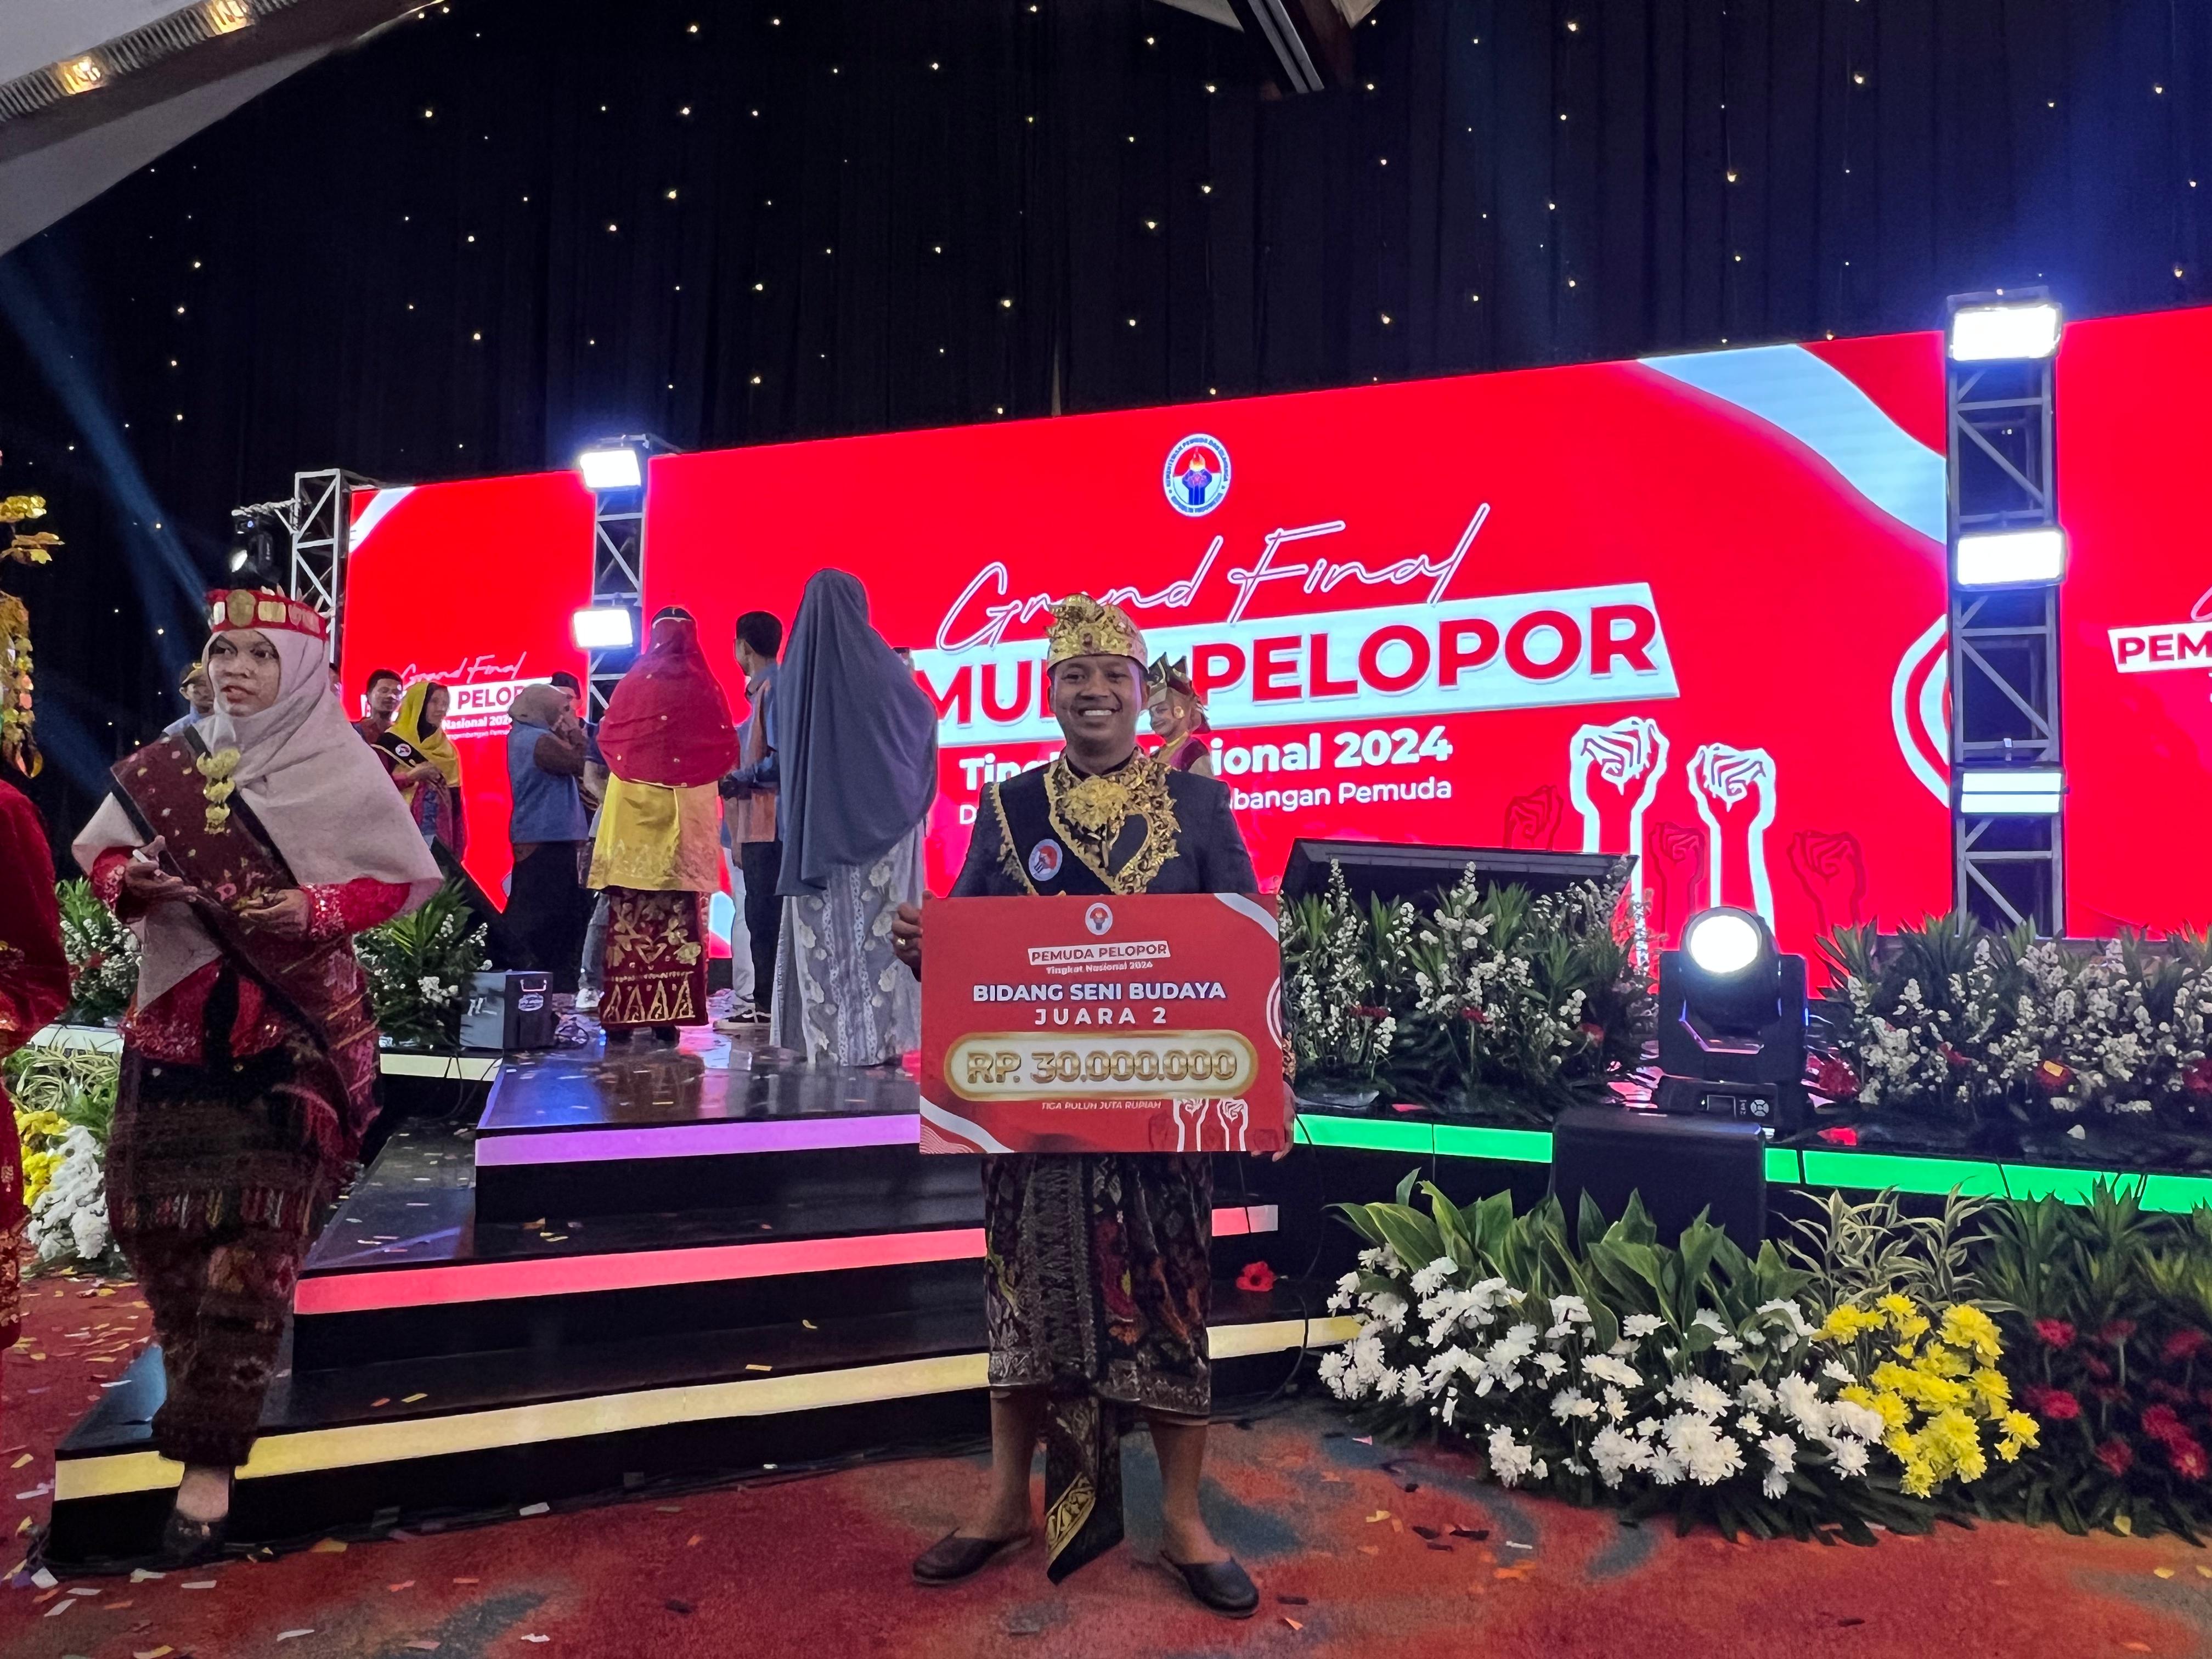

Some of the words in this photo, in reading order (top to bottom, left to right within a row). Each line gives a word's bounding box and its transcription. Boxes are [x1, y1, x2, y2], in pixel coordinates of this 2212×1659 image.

[936, 535, 1223, 656] Grnd
[1227, 502, 1491, 625] Final
[1192, 603, 1657, 706] PELOPOR
[1209, 733, 1322, 776] ional
[1334, 725, 1453, 768] 2024
[1229, 787, 1331, 812] bangan
[1338, 776, 1452, 804] Pemuda
[1032, 948, 1094, 962] PEMUDA
[1099, 944, 1167, 958] PELOPOR
[973, 984, 1063, 1002] BIDANG
[1070, 983, 1122, 1001] SENI
[1129, 982, 1227, 1000] BUDAYA
[1035, 1007, 1136, 1025] JUARA
[1153, 1006, 1167, 1024] 2
[967, 1050, 1022, 1084] RP.
[1030, 1049, 1237, 1084] 30.000.000
